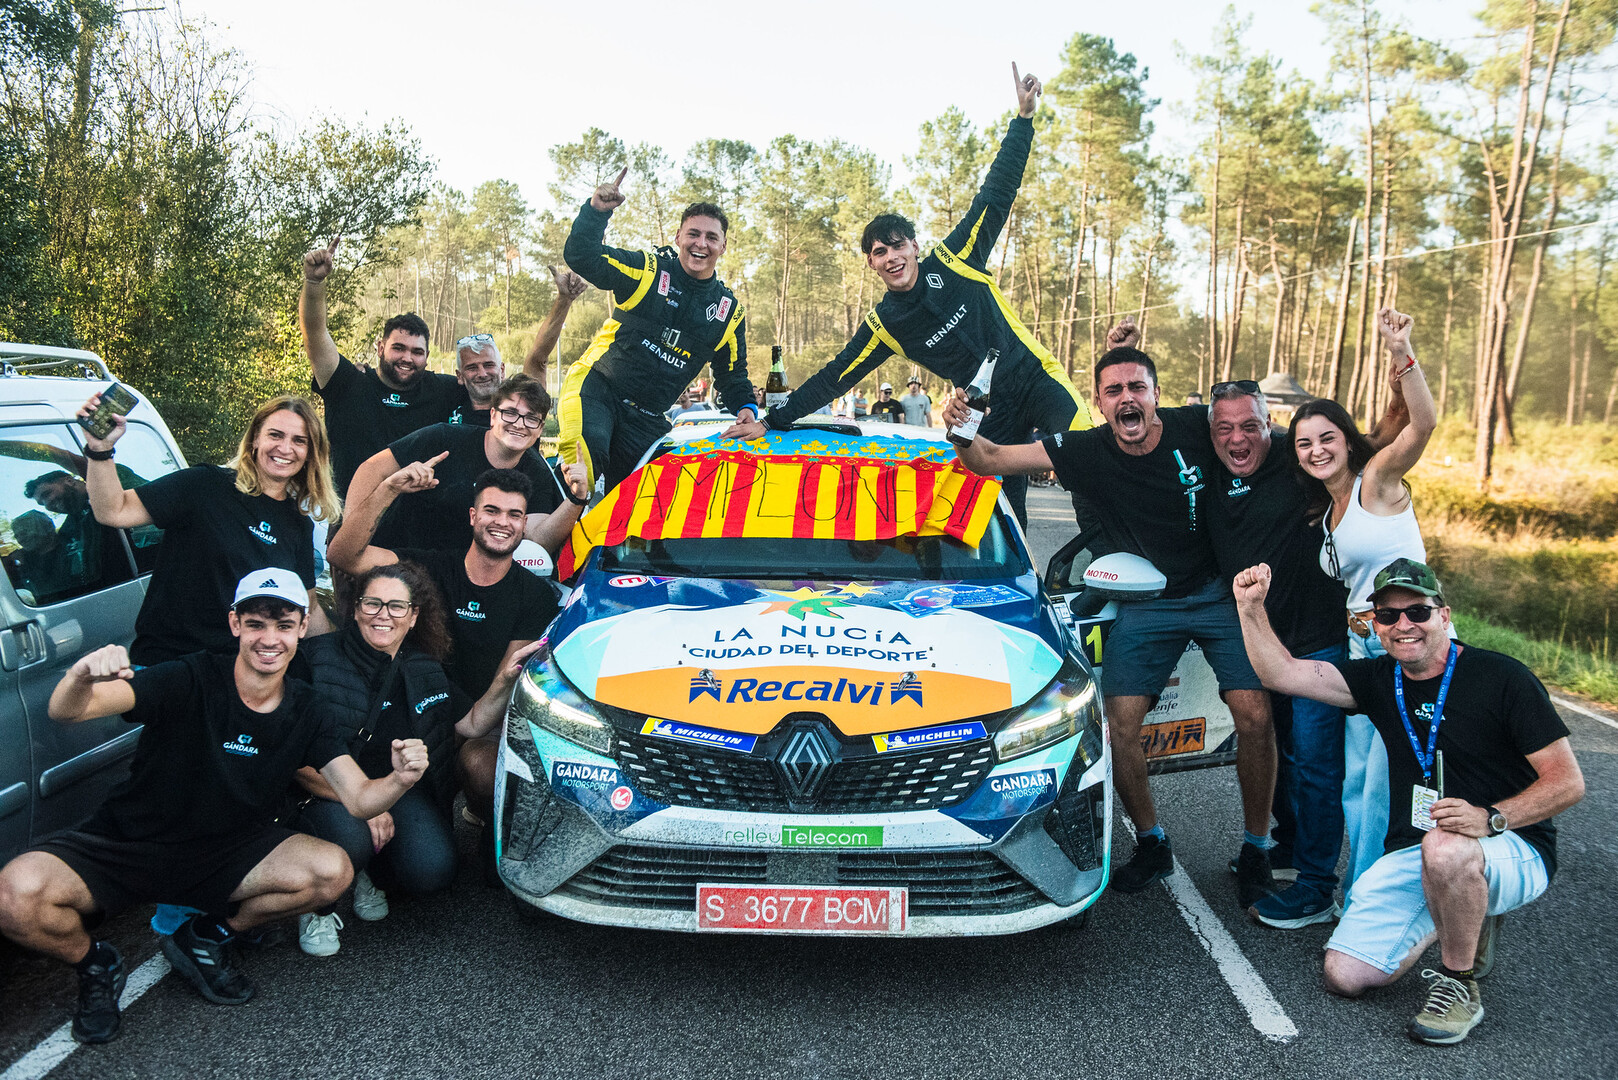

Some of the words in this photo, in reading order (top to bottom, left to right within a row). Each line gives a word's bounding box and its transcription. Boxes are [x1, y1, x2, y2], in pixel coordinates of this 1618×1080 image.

[925, 304, 968, 348] RENAULT
[641, 338, 687, 369] RENAULT
[516, 559, 544, 567] OTRIO
[1086, 569, 1119, 581] MOTRIO
[456, 607, 487, 619] GÁNDARA
[714, 627, 754, 643] LA
[689, 645, 773, 659] CIUDAD
[780, 644, 819, 655] DEL
[826, 645, 929, 662] DEPORTE
[726, 678, 885, 706] Recalvi
[673, 727, 743, 745] MICHELIN
[908, 728, 973, 744] MICHELIN
[223, 741, 259, 755] GÁNDARA
[561, 778, 610, 791] MOTORSPORT
[1002, 786, 1048, 800] MOTORSPORT
[705, 894, 726, 922] S
[744, 896, 814, 924] 3677
[823, 897, 887, 924] BCM
